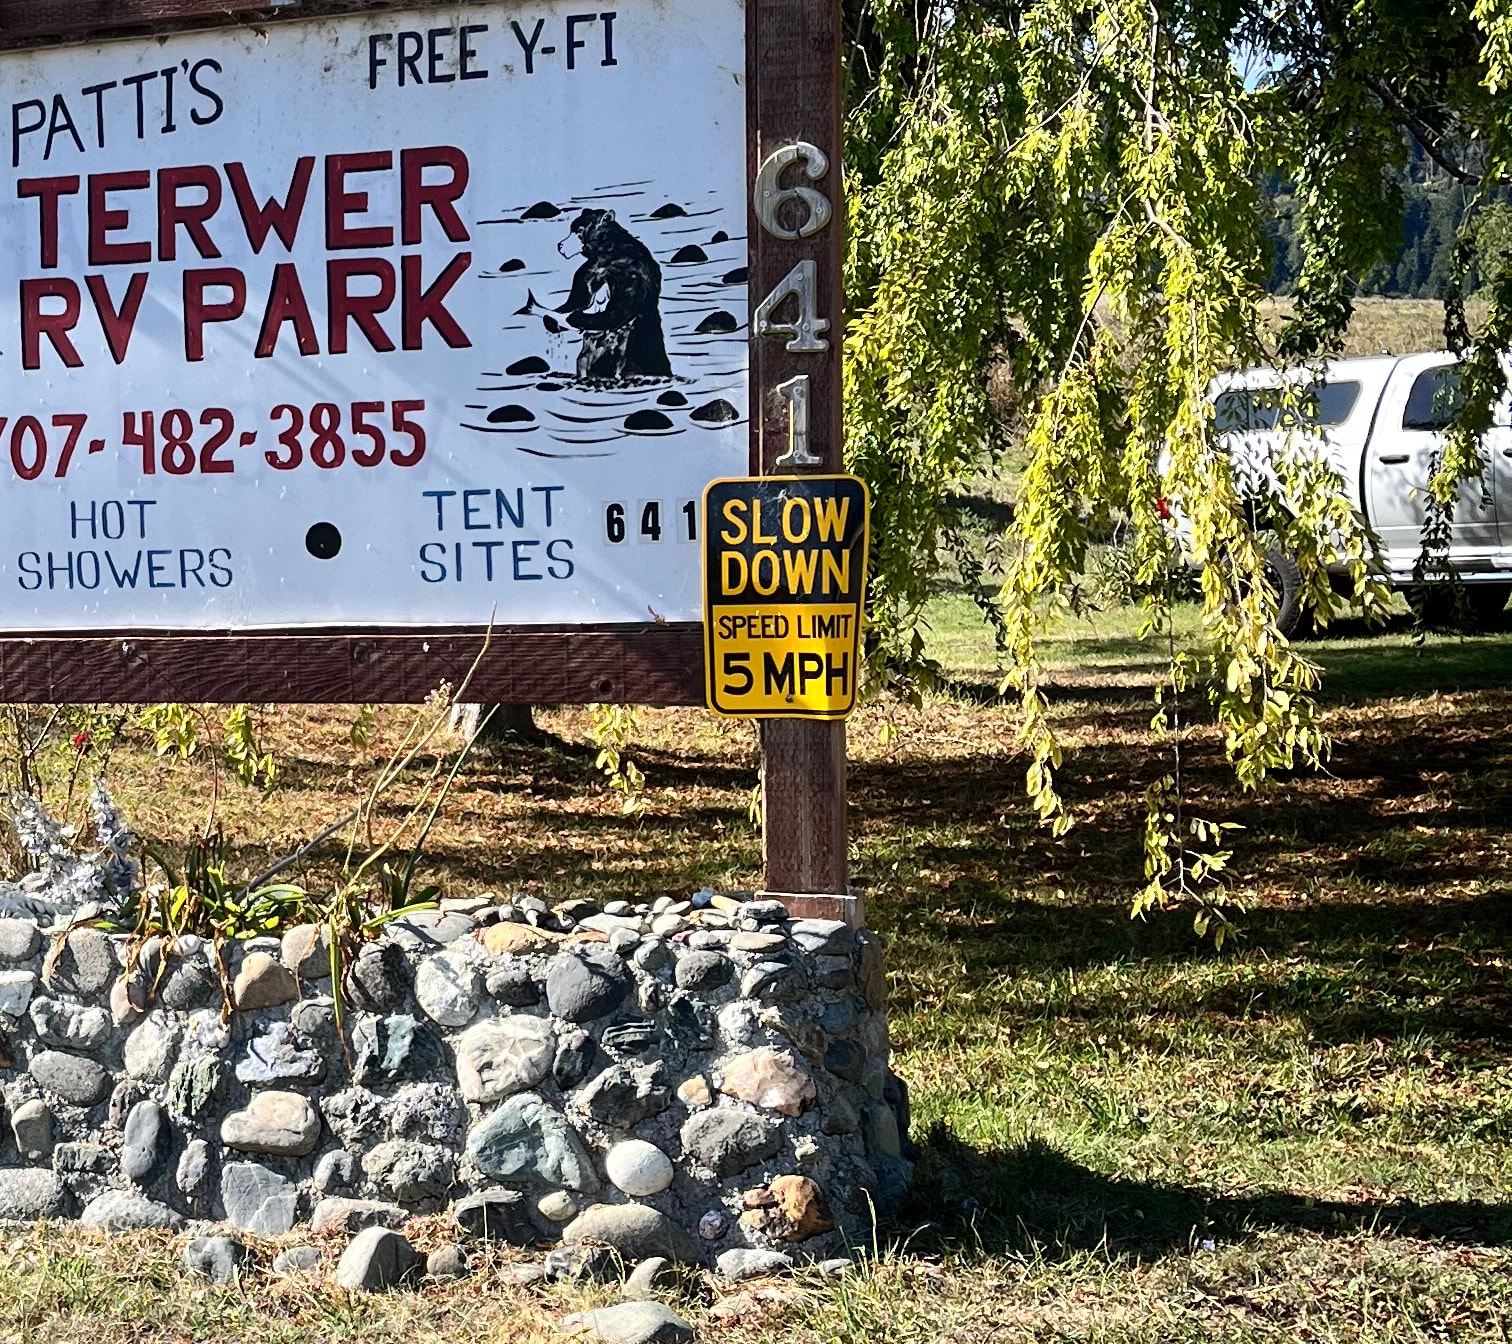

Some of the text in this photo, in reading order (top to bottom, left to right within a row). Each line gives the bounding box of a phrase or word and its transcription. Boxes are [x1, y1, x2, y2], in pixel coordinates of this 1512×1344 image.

[369, 11, 618, 89] FREE Y-FI
[12, 58, 224, 167] PATTI'S
[17, 145, 471, 269] TERWER
[20, 251, 473, 371] RV PARK
[71, 500, 157, 539] HOT
[422, 485, 565, 531] TENT
[606, 500, 697, 544] 641
[720, 497, 850, 545] SLOW
[18, 548, 234, 590] SHOWERS
[420, 539, 575, 583] SITES
[721, 549, 850, 596] DOWN
[718, 613, 853, 640] SPEED LIMIT
[722, 651, 849, 697] 5 MPH
